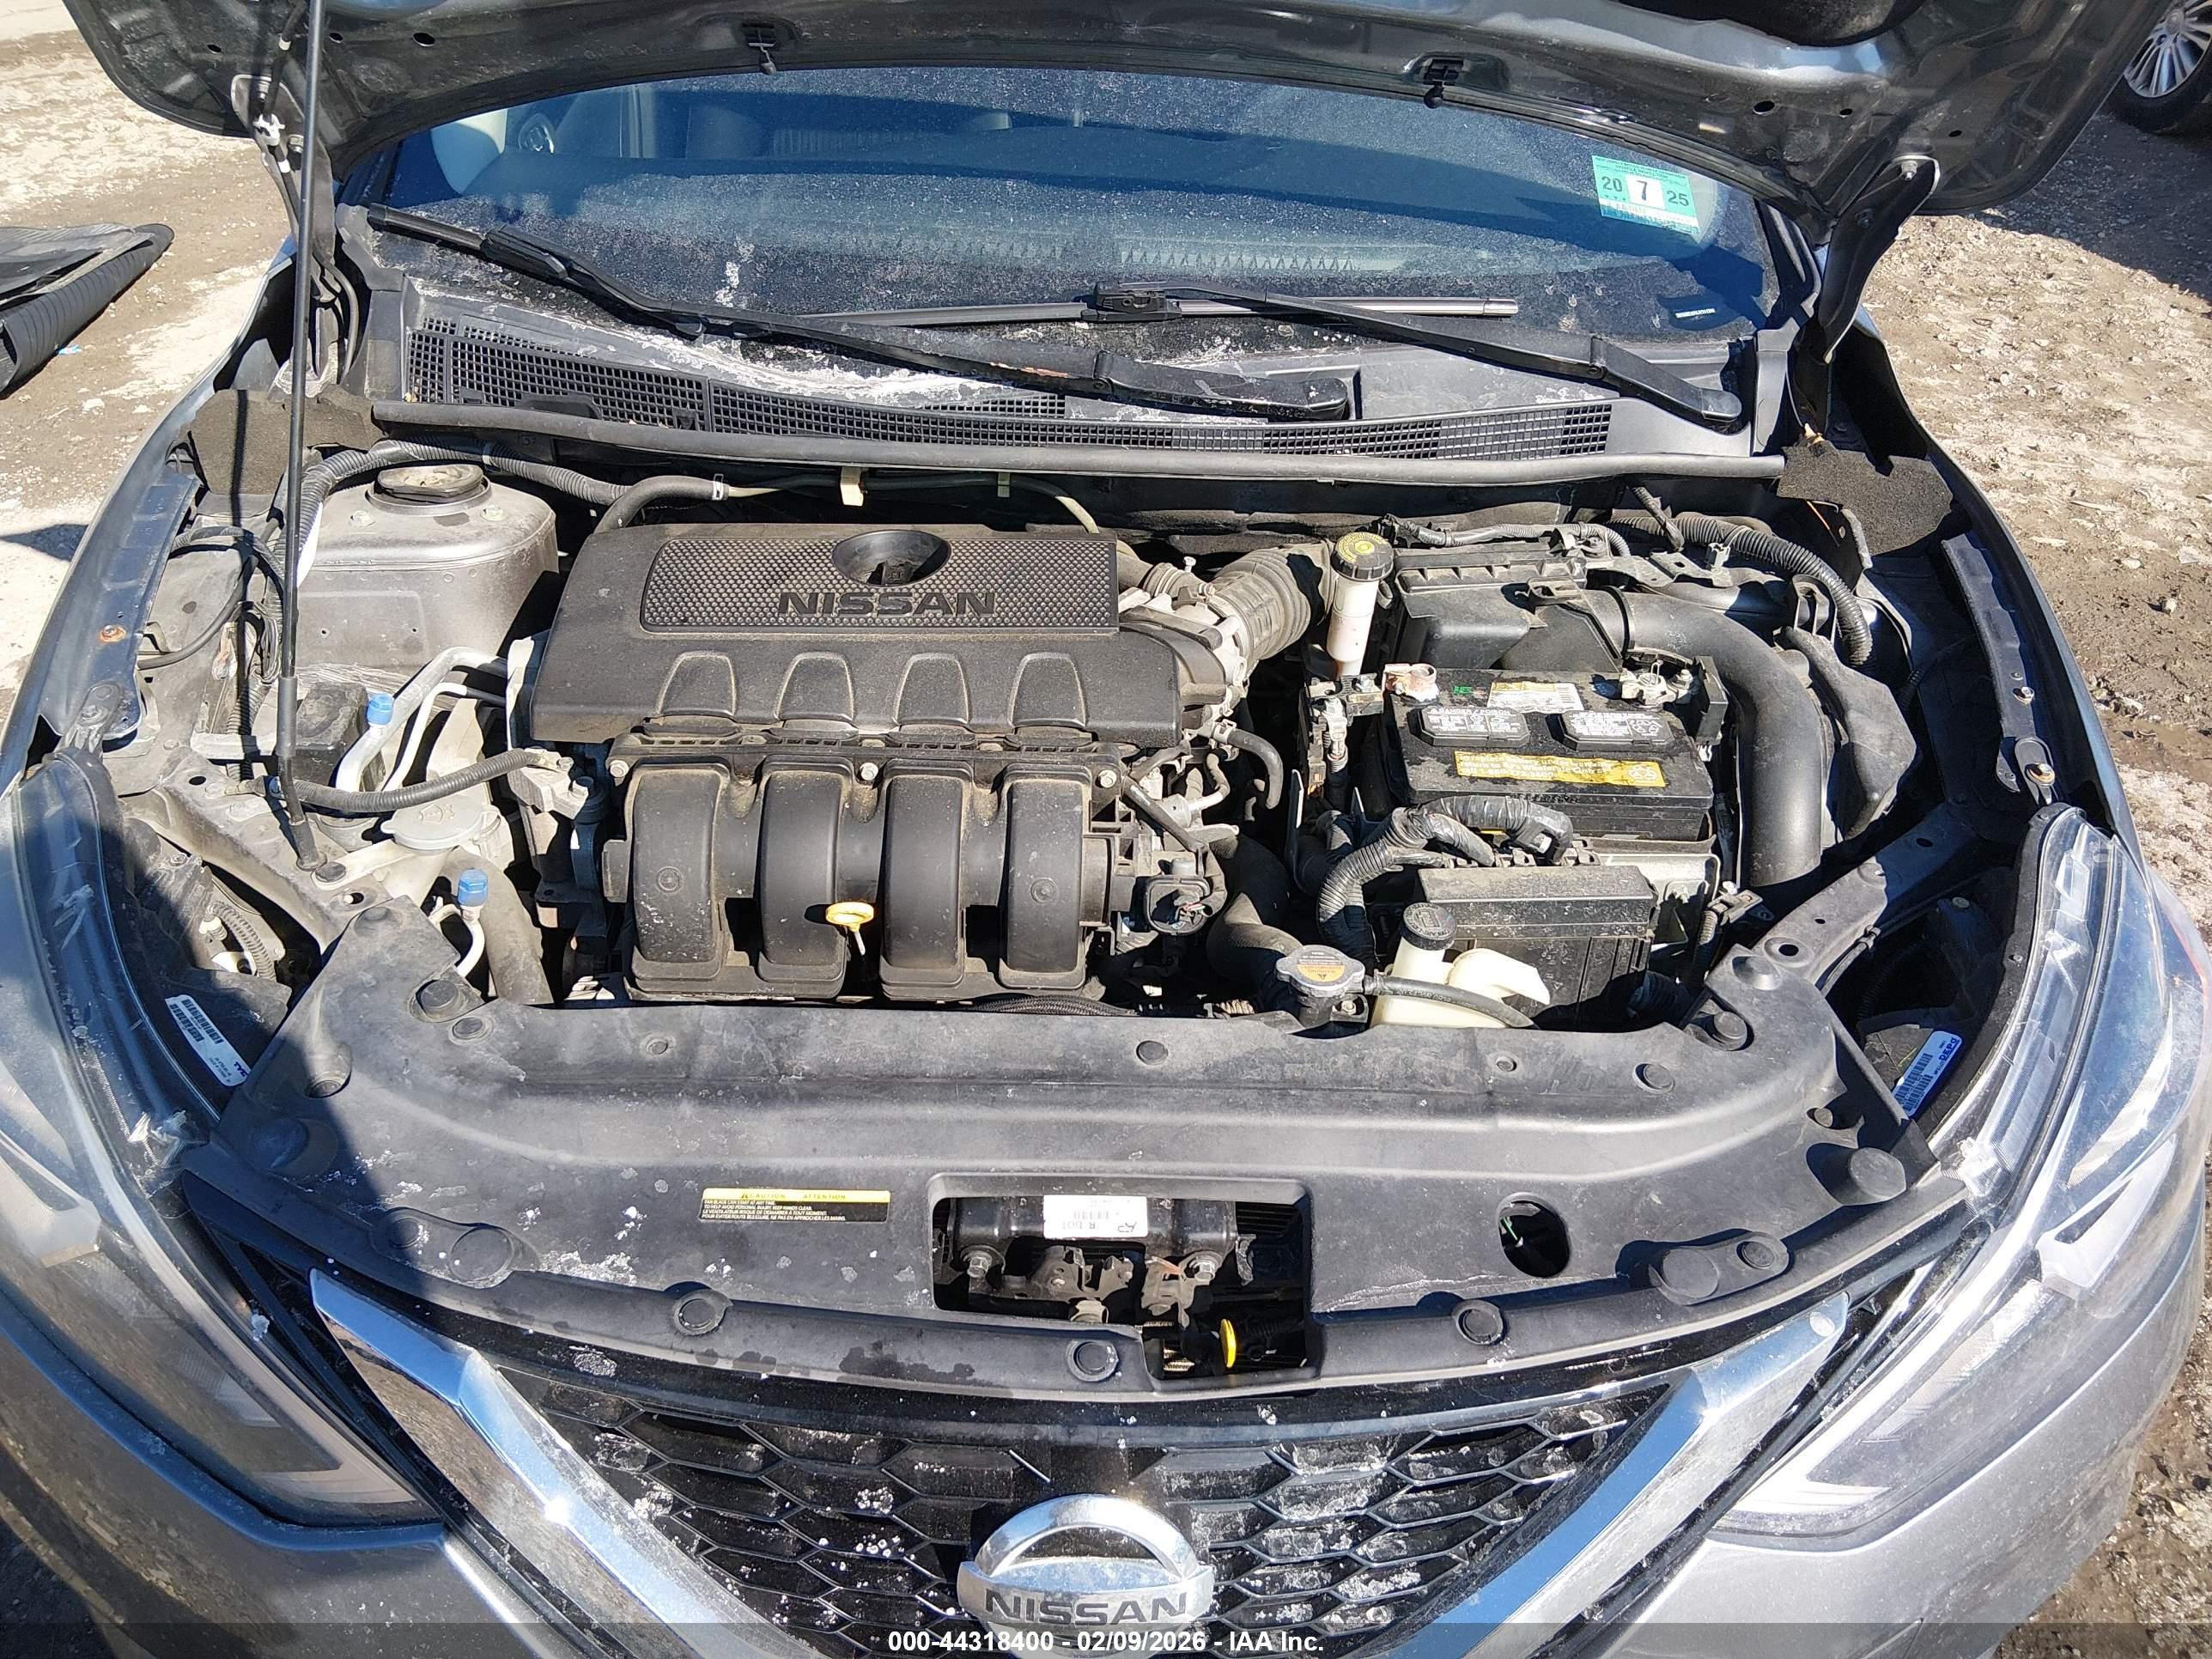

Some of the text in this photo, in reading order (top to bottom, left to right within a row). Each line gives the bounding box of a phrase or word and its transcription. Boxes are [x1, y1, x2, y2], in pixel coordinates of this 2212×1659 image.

[1601, 176, 1689, 207] 20 7 25
[778, 592, 996, 617] NISSAN
[1938, 1036, 1959, 1061] DEPO
[985, 1590, 1188, 1626] NISSAN
